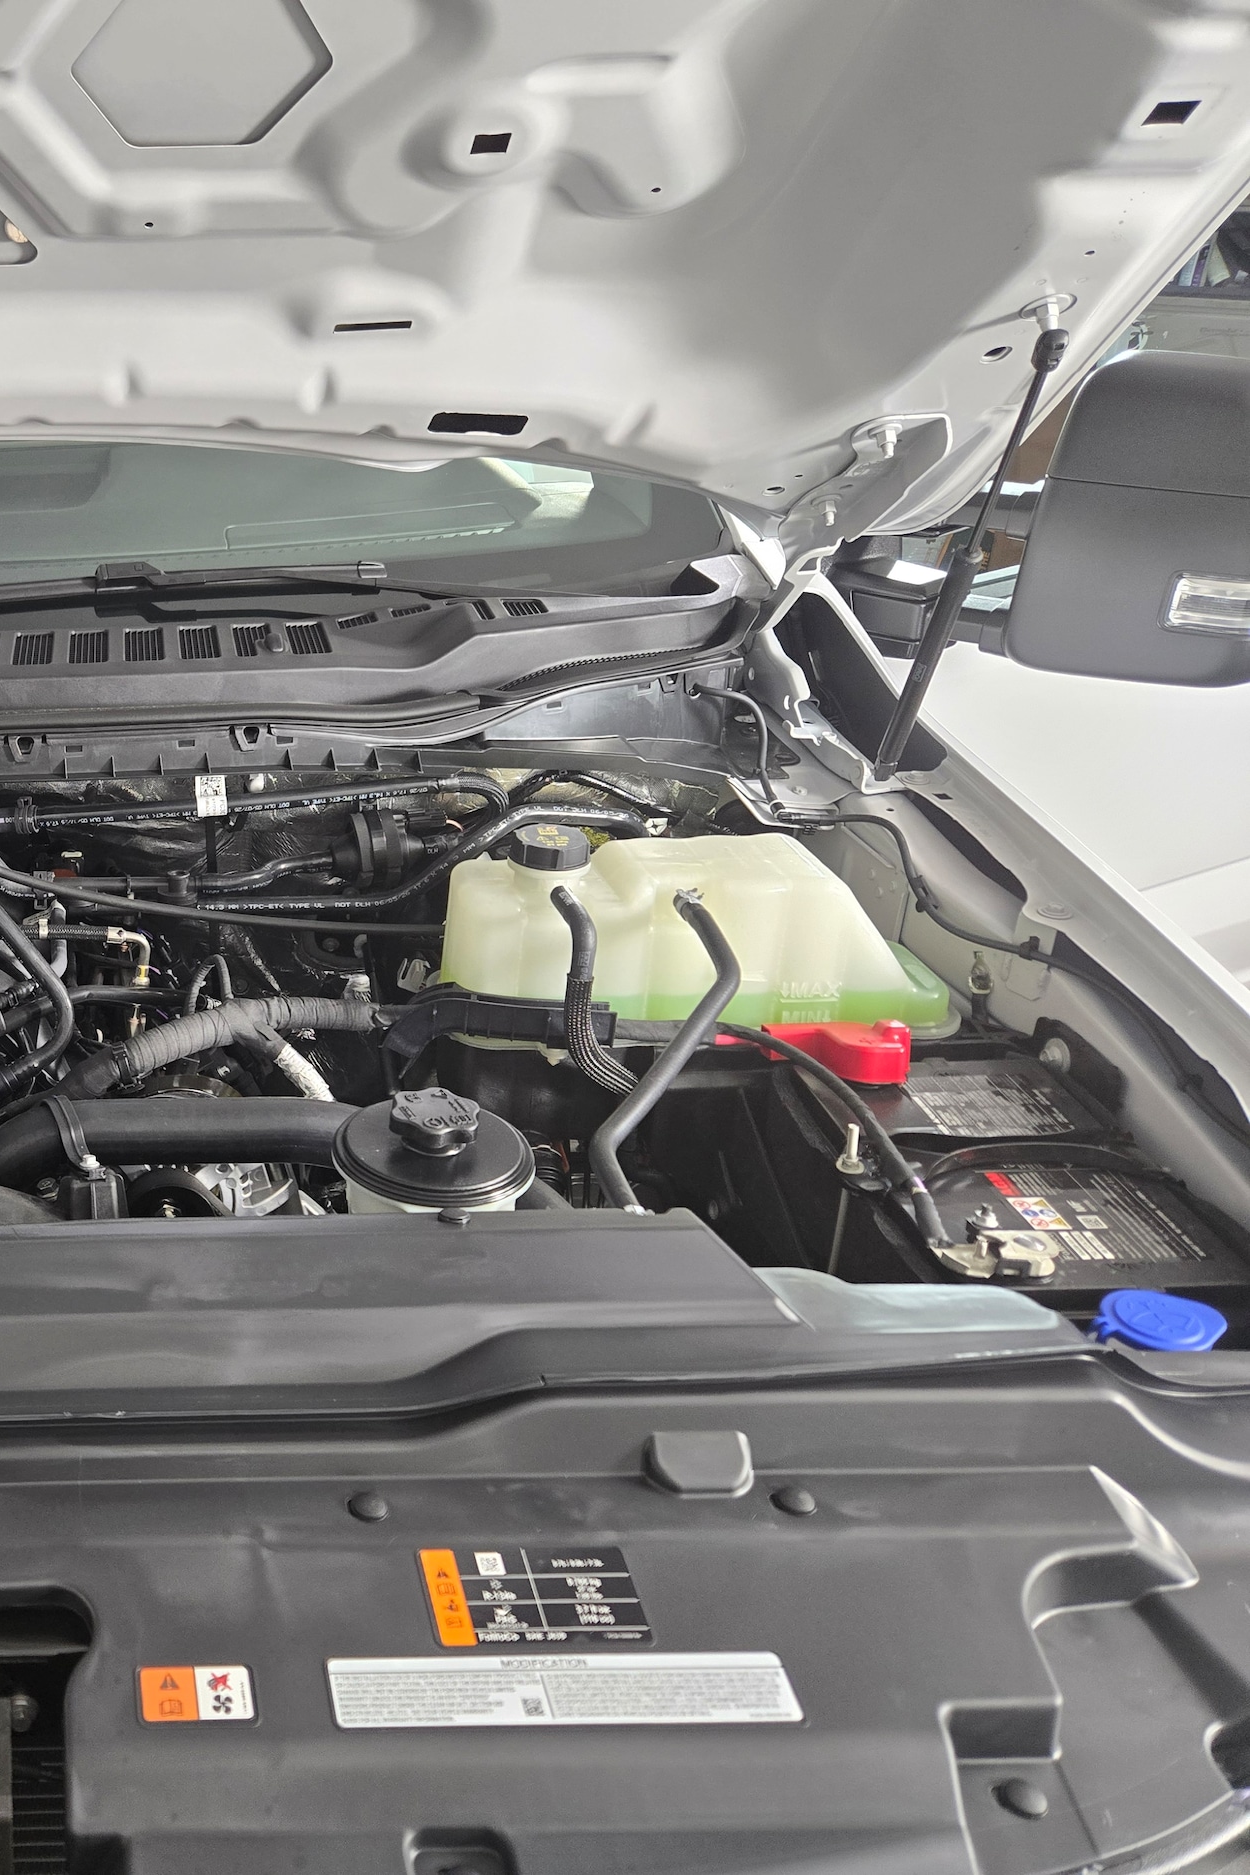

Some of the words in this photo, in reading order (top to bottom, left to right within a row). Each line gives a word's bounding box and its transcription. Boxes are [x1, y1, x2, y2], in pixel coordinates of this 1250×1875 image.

[790, 981, 842, 998] MAX
[781, 1010, 822, 1024] MIN
[500, 1658, 588, 1669] MODIFICATION
